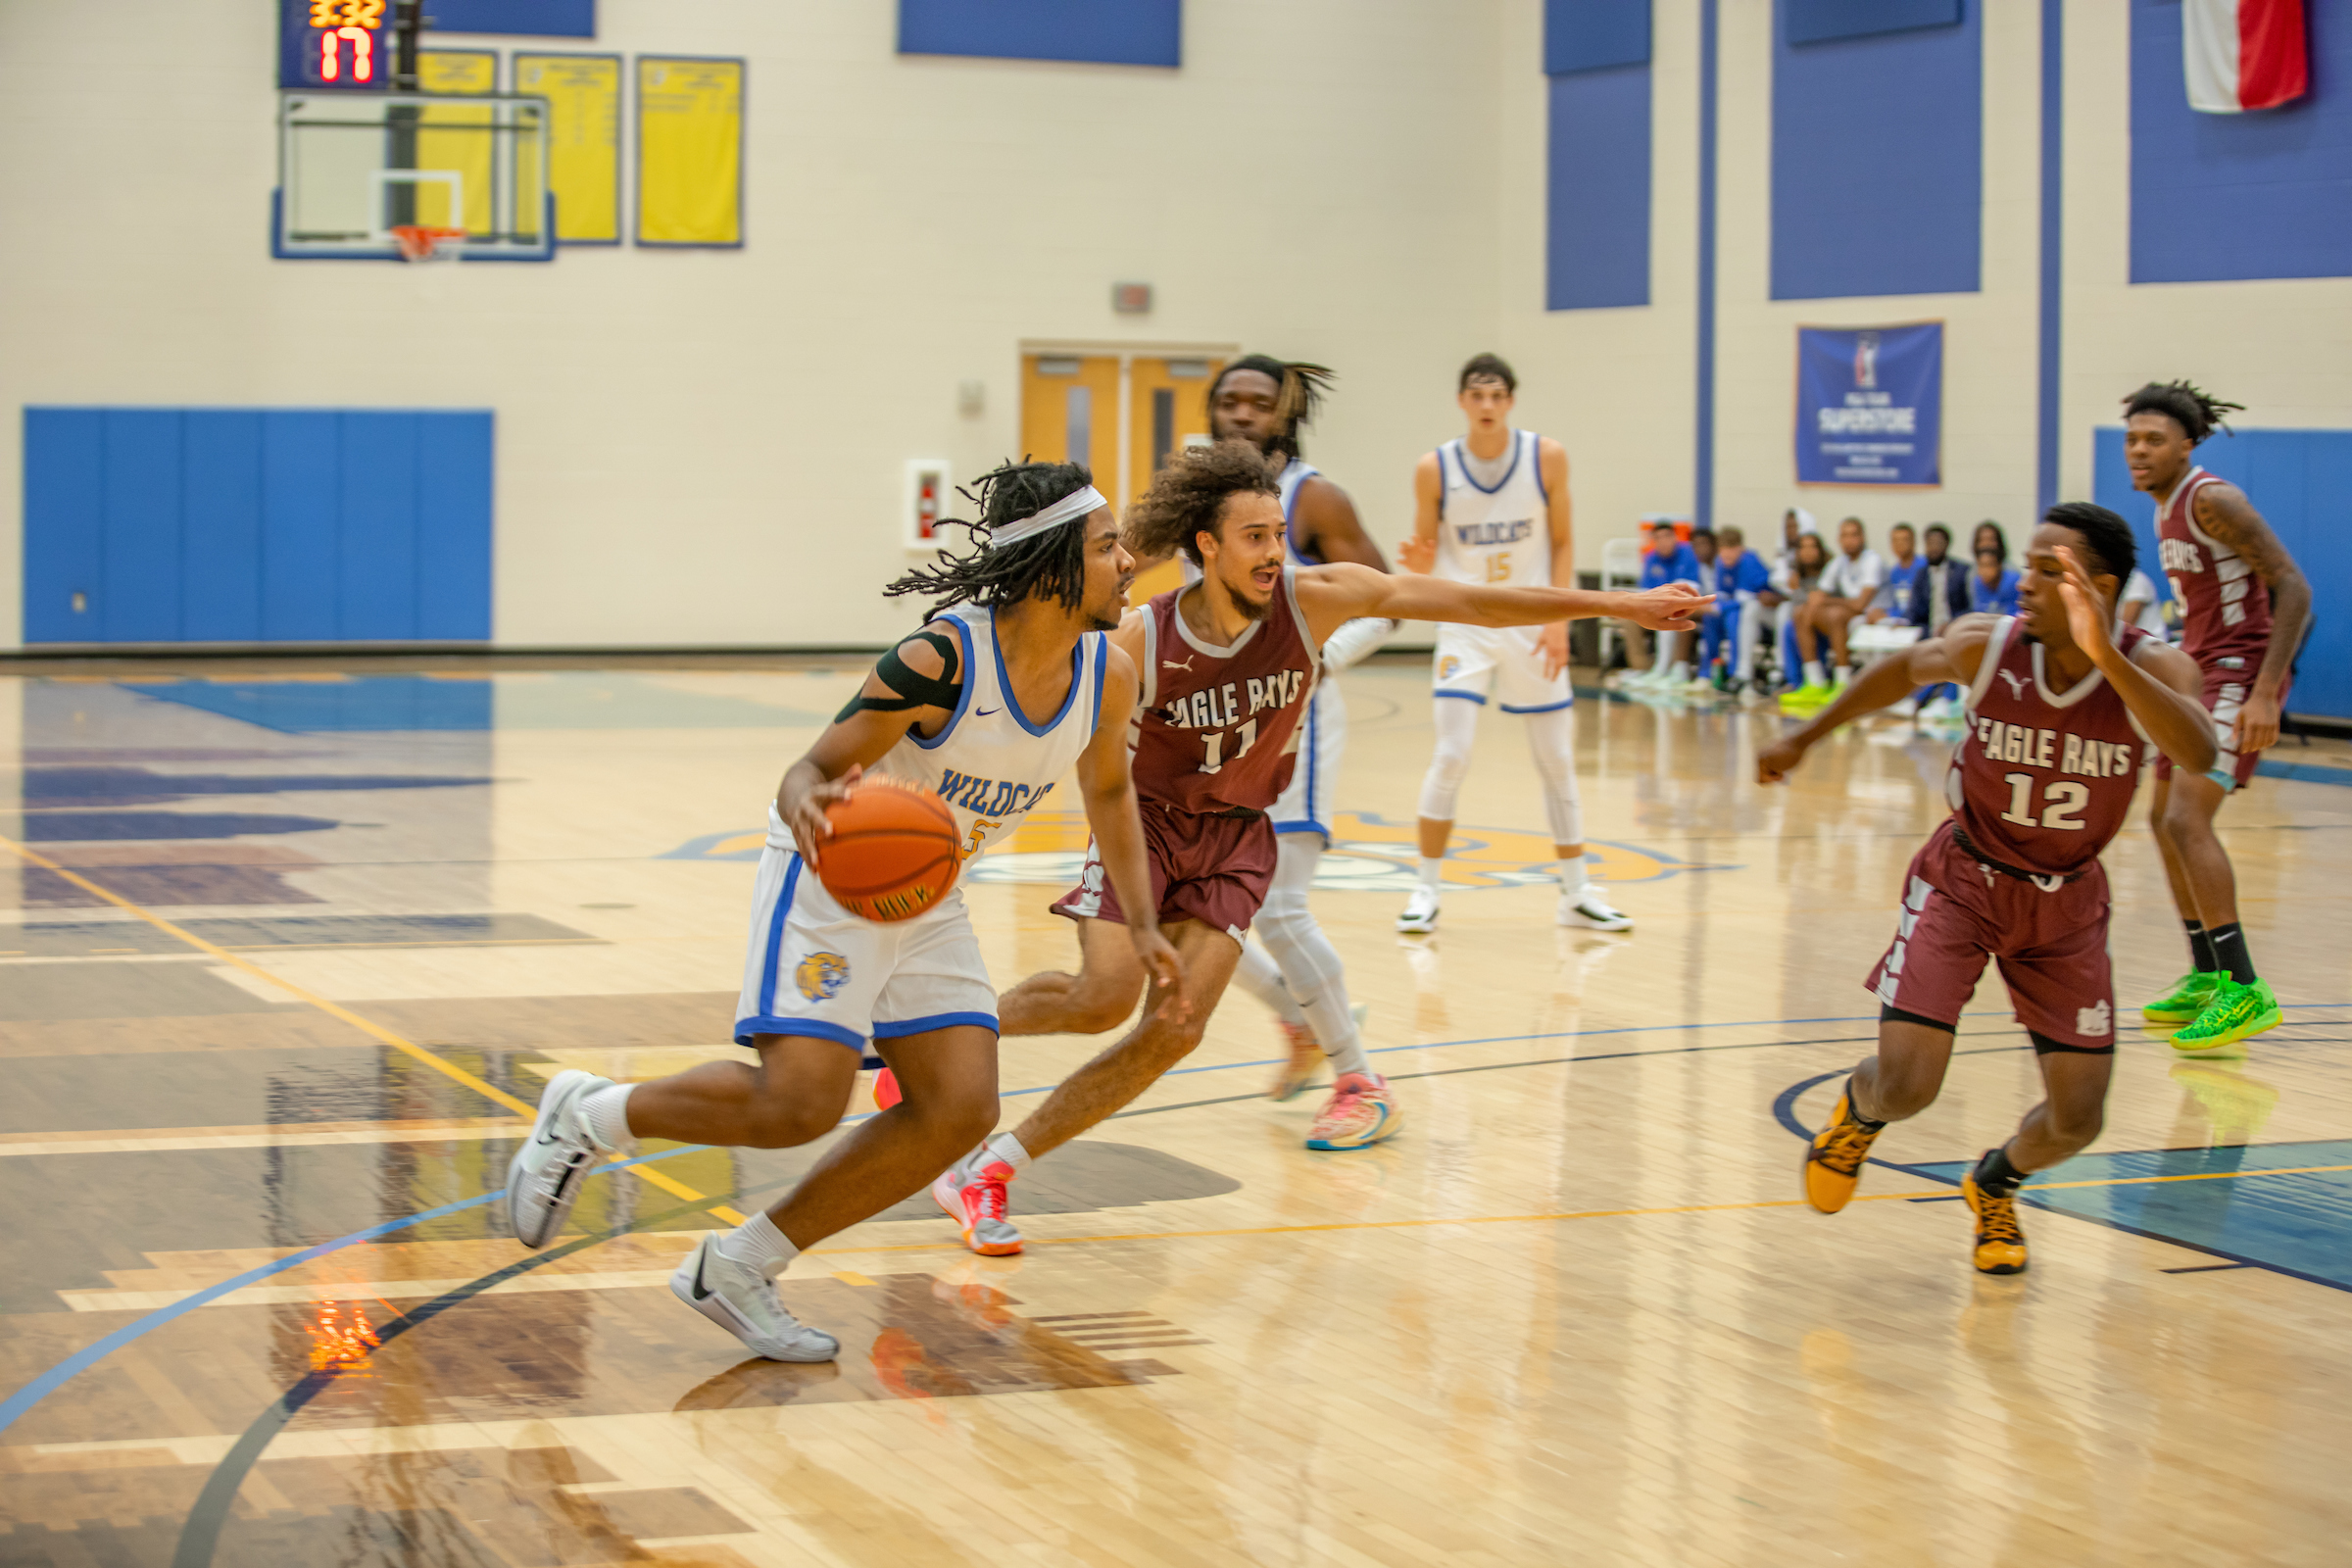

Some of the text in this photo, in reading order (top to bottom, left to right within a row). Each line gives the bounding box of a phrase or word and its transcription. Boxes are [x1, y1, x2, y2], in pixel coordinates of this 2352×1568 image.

[320, 26, 373, 83] 17
[1486, 552, 1512, 583] 15
[1247, 669, 1304, 716] RAYS
[1198, 717, 1257, 775] 11
[1977, 716, 2132, 778] EAGLE RAYS
[2000, 771, 2090, 831] 12
